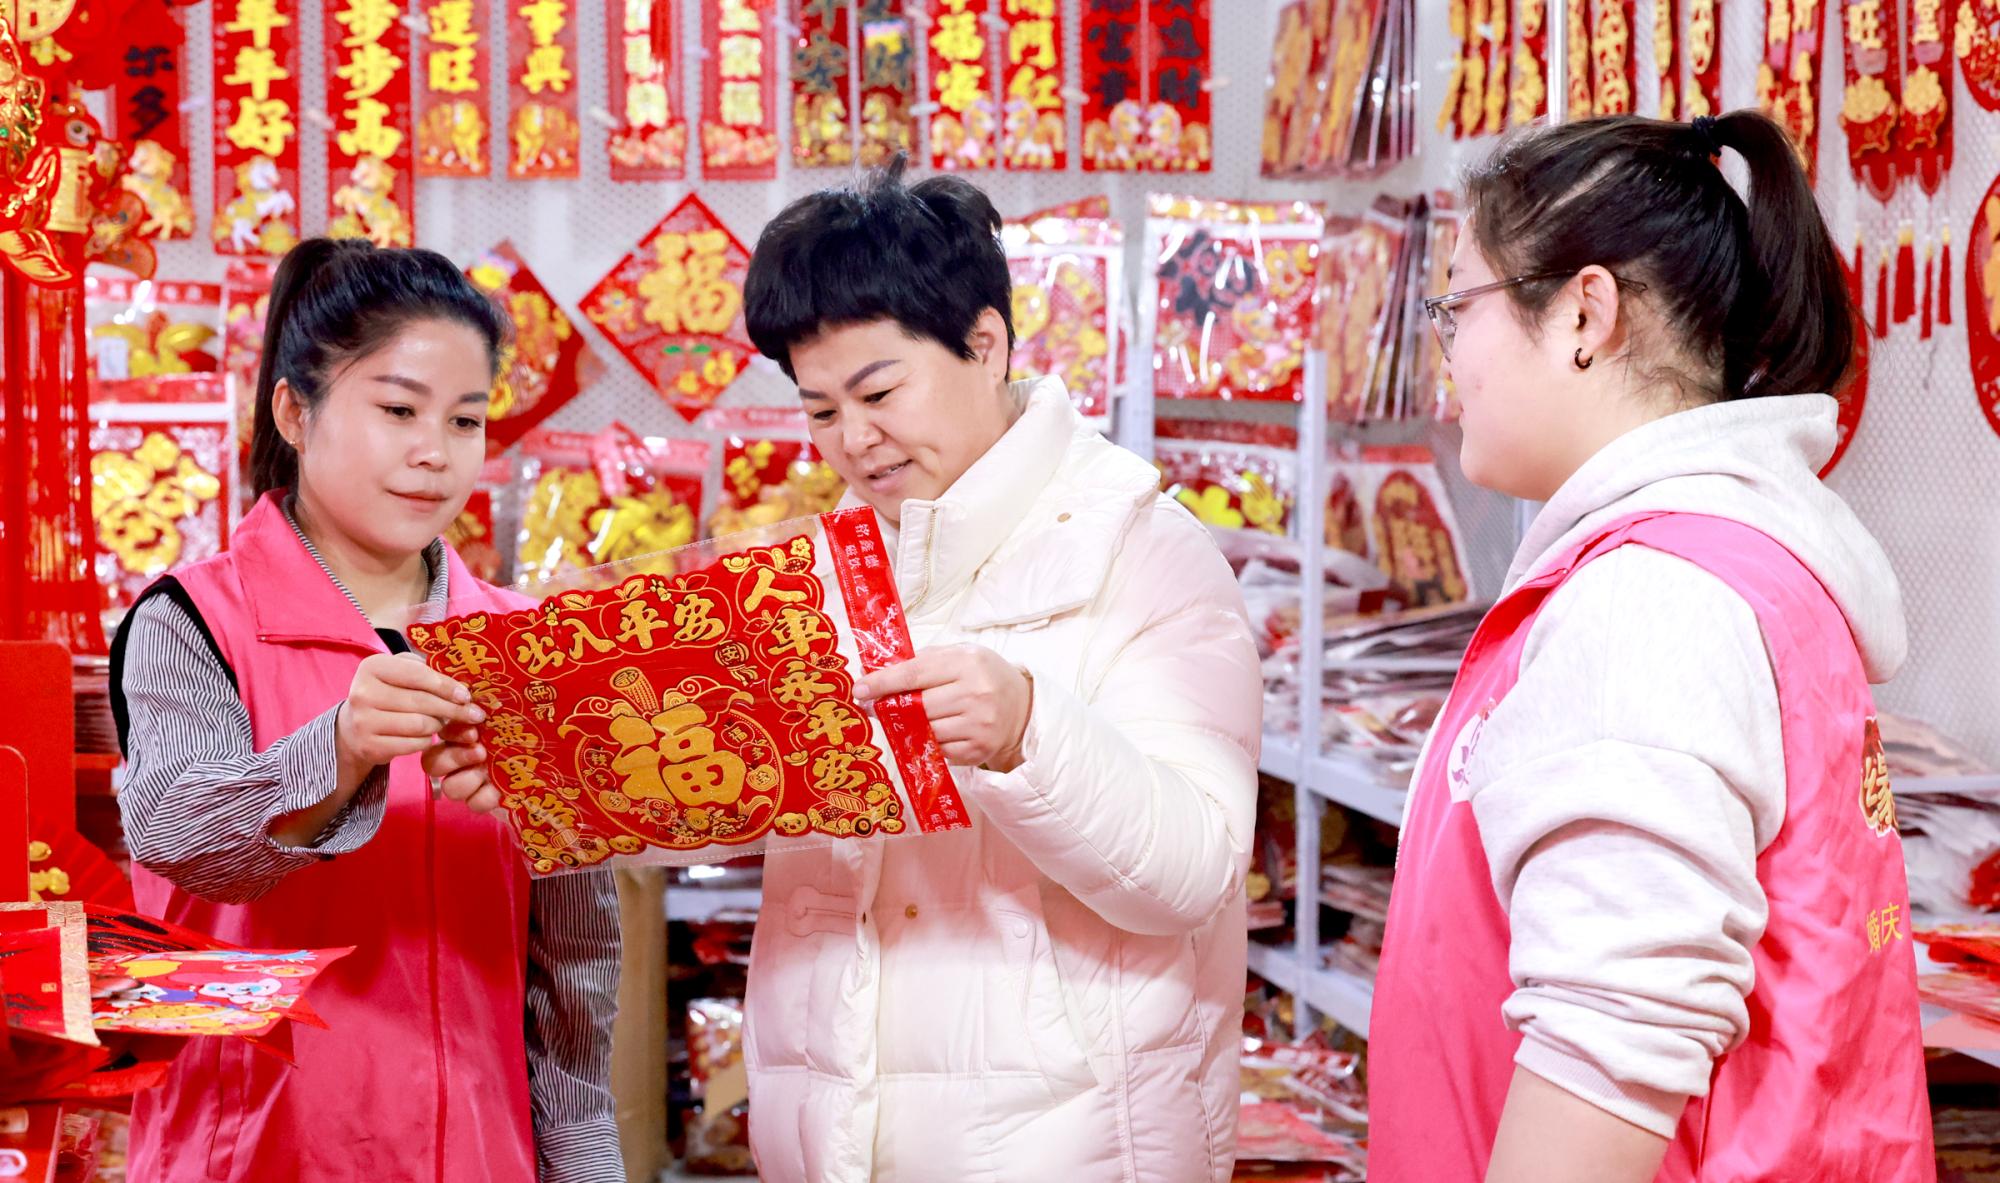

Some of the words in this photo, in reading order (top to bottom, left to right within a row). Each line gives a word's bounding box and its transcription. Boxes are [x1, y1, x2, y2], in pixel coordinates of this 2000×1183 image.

[639, 229, 741, 334] 福
[516, 593, 727, 675] 出入平安
[608, 702, 747, 807] 福
[1866, 902, 1903, 954] 婚庆
